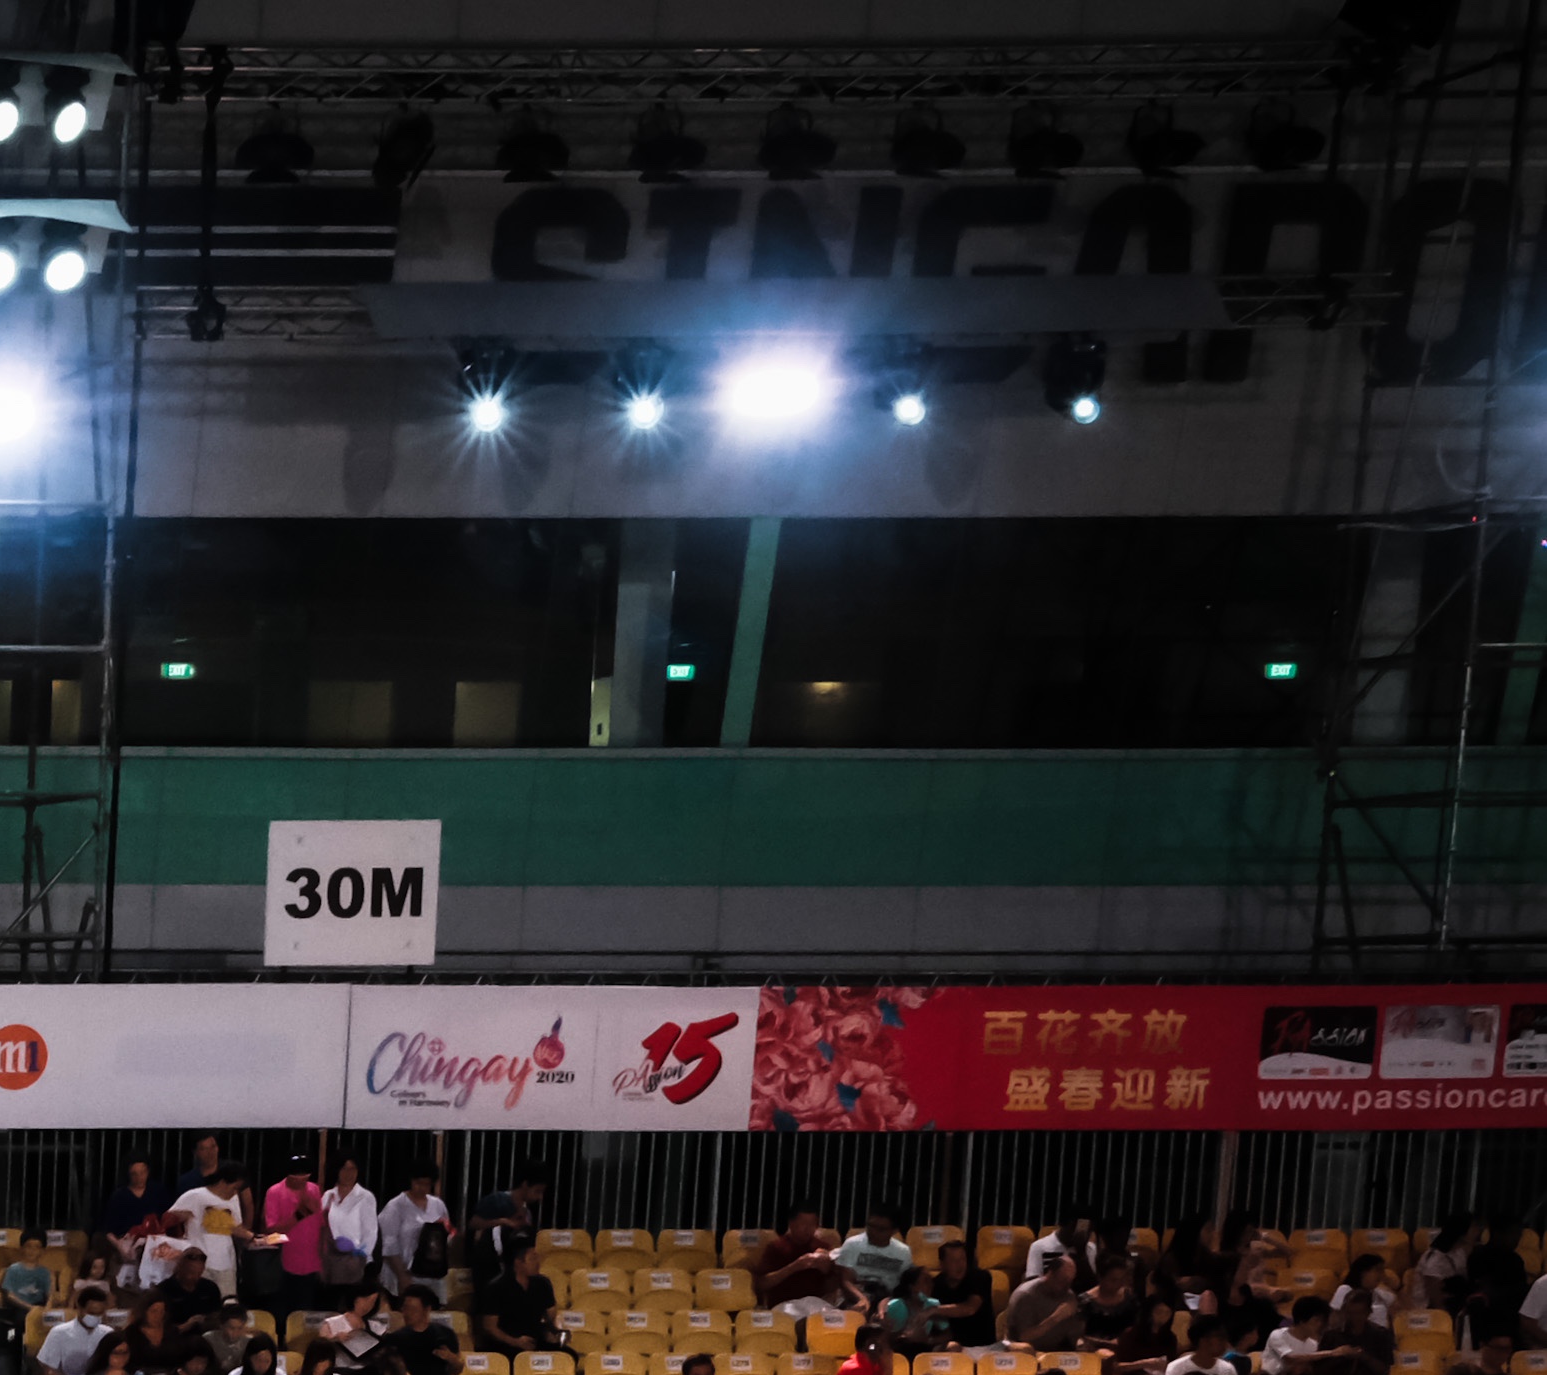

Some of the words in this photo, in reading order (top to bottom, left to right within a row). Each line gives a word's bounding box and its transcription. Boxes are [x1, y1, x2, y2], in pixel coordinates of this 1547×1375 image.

[285, 867, 424, 920] 30M
[642, 1011, 739, 1105] 15
[982, 1008, 1188, 1055] 百花齐放
[366, 1032, 533, 1110] Chingay
[536, 1070, 575, 1083] 2020
[1003, 1066, 1212, 1111] 盛春迎新
